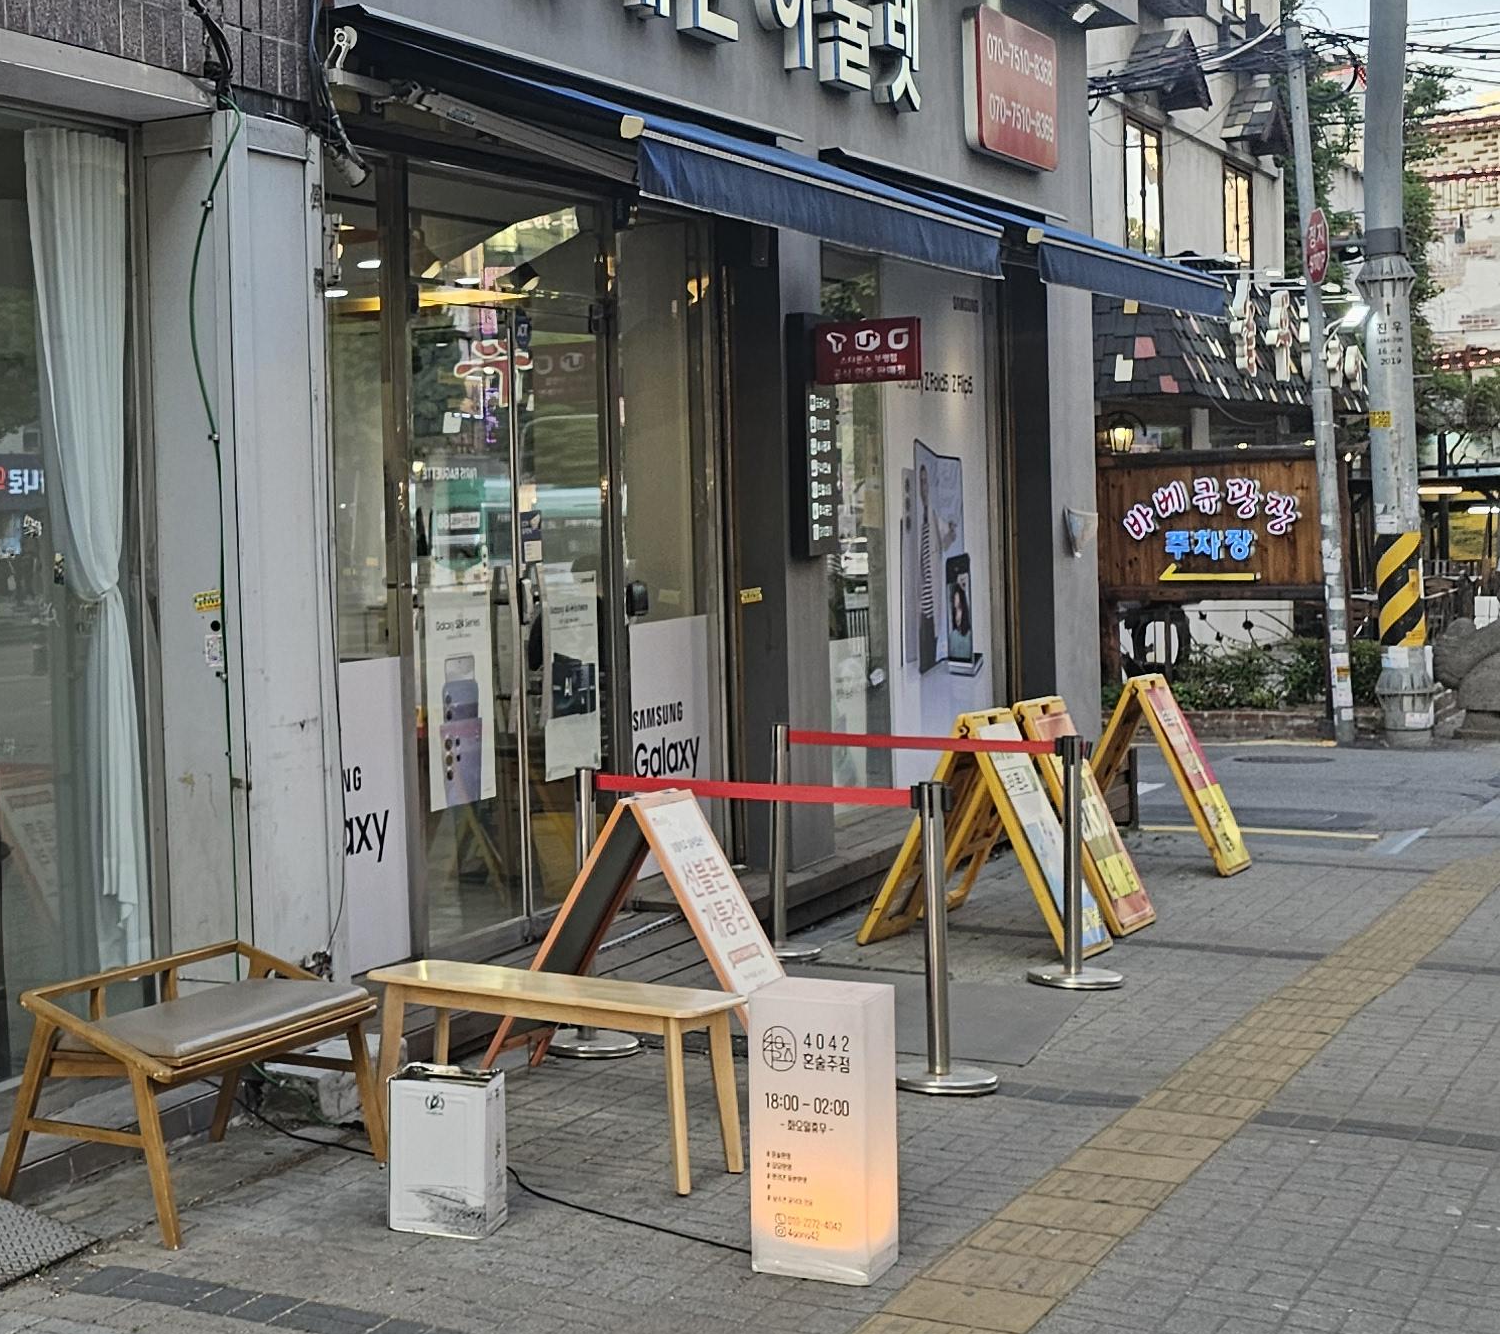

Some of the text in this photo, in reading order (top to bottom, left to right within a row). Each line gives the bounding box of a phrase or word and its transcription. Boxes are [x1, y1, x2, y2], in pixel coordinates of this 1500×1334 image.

[1308, 224, 1325, 250] 정지
[1309, 251, 1327, 274] STOP
[1380, 356, 1402, 366] 2019
[1122, 476, 1298, 542] 바베큐광장
[1164, 529, 1254, 561] 주차장
[632, 701, 684, 732] SAMSUNG
[634, 735, 701, 779] Galaxy
[803, 1032, 850, 1053] 4042
[802, 1053, 851, 1074] 혼술주점
[764, 1092, 799, 1112] 18:00
[813, 1097, 850, 1117] 02:00
[786, 1119, 827, 1135] 화요일휴무
